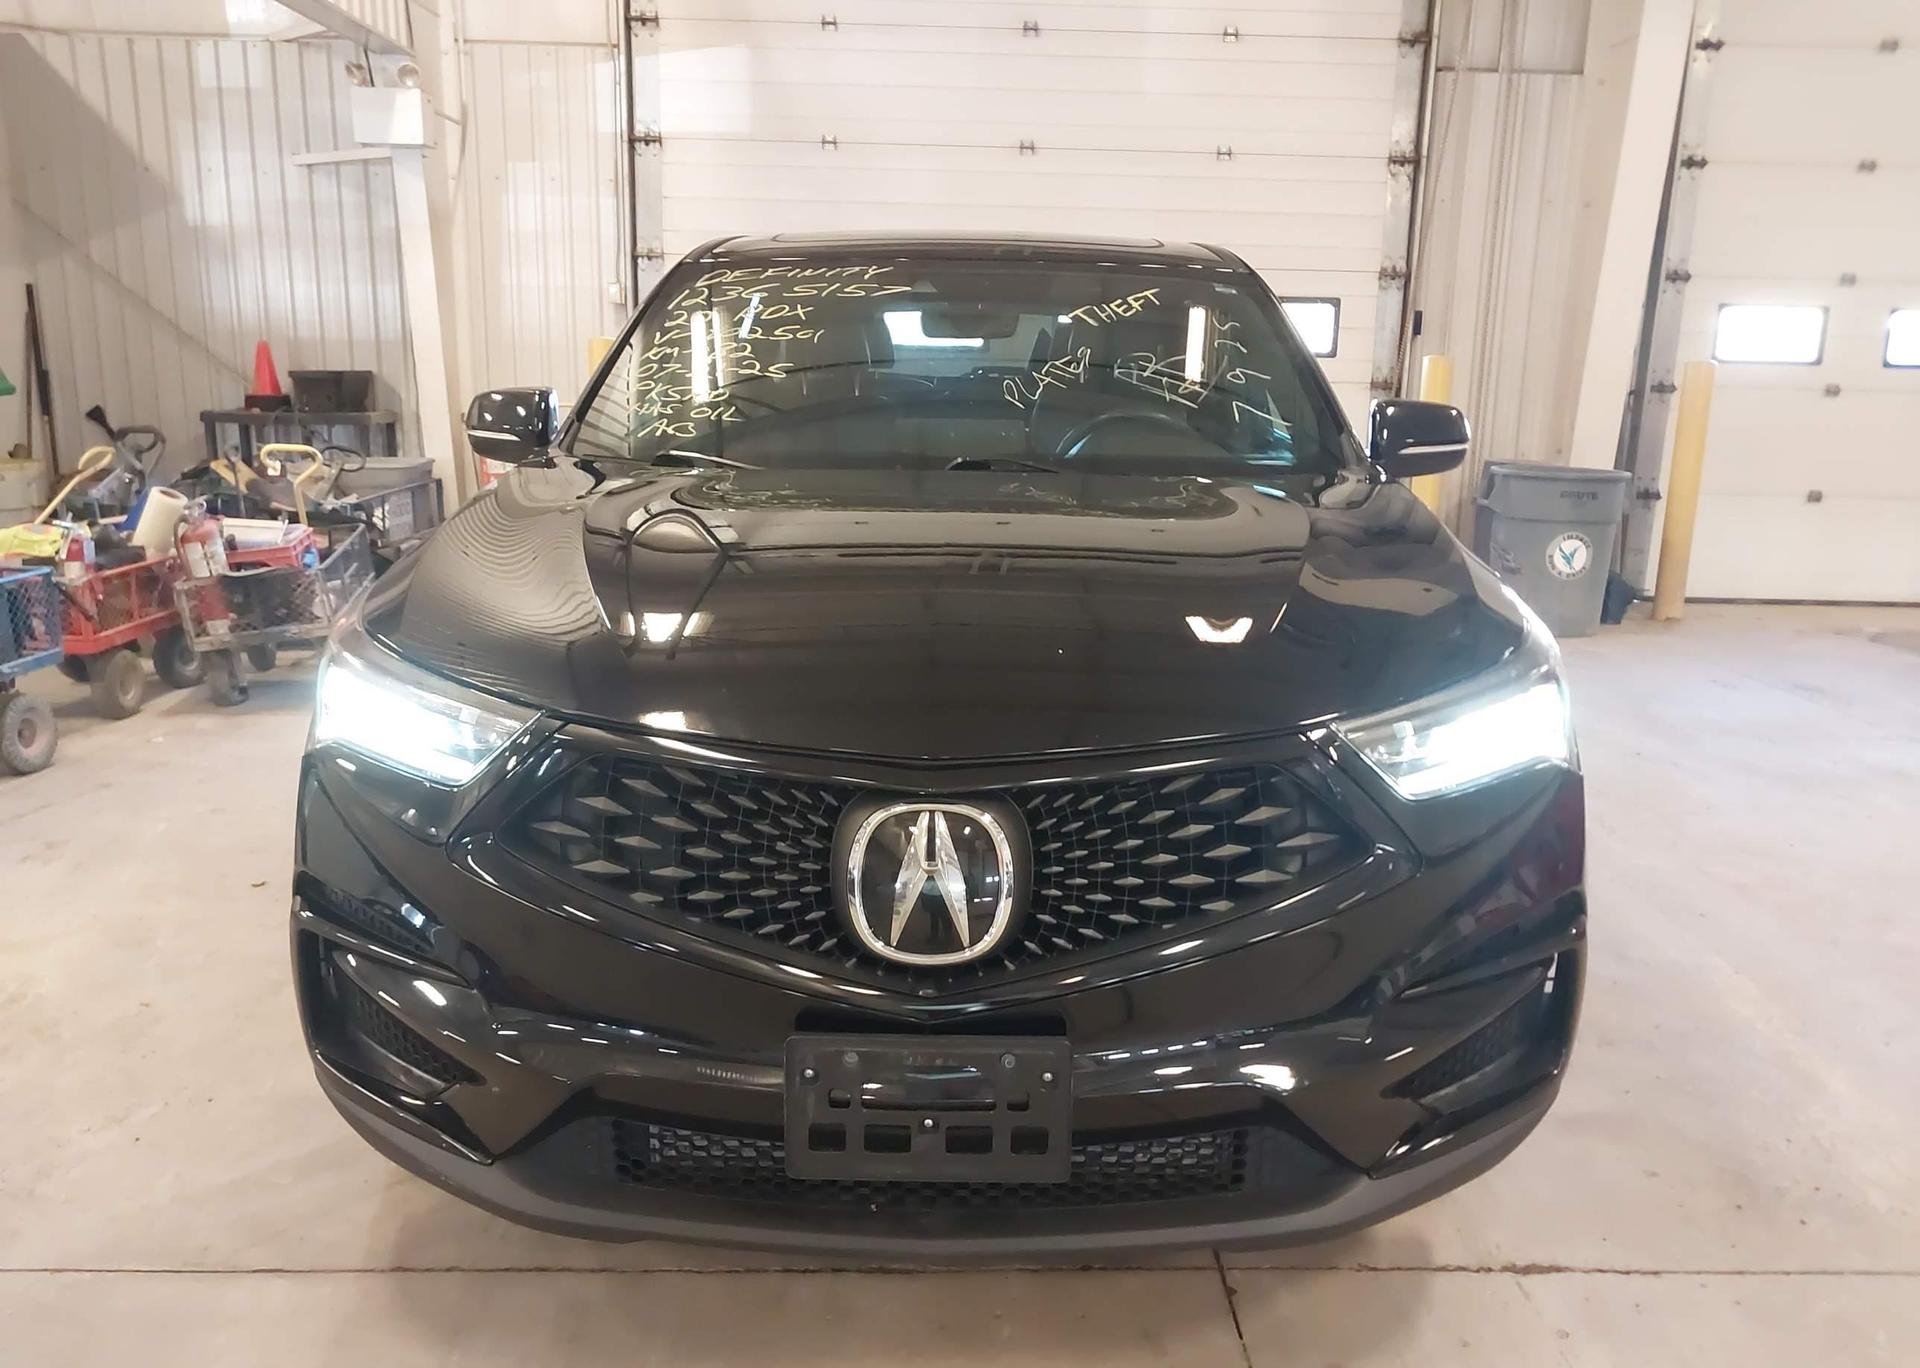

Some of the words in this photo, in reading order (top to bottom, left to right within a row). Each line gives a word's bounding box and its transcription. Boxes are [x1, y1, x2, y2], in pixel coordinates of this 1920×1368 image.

[694, 265, 894, 288] DEFINITY
[1067, 288, 1160, 326] THEFT
[690, 406, 747, 421] OIL
